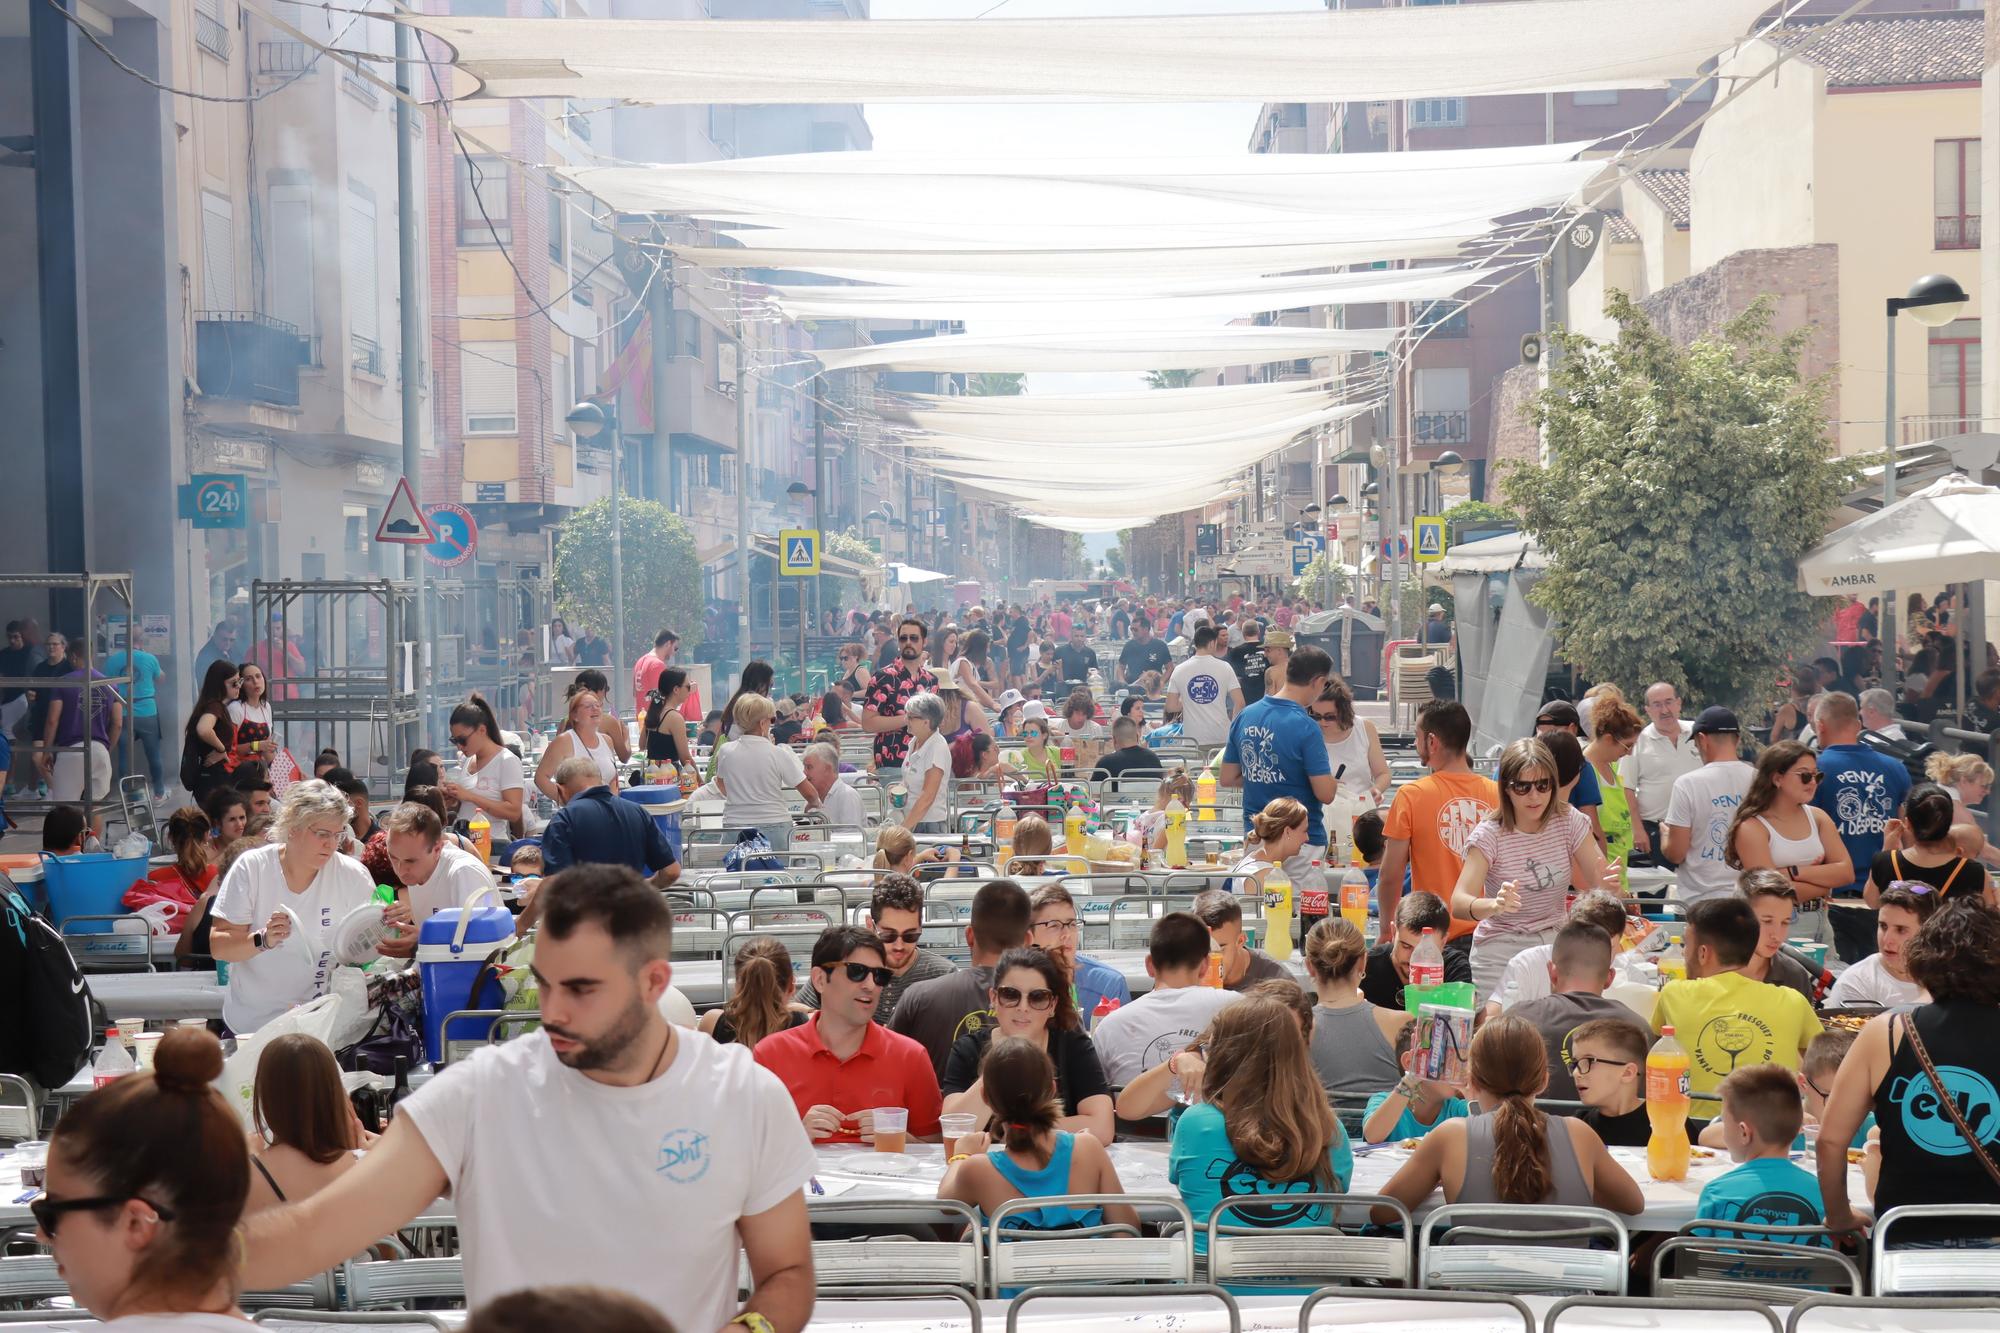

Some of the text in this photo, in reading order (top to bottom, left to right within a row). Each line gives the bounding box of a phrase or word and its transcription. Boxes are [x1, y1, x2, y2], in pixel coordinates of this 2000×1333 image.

[425, 504, 464, 517] EXCEPTO
[440, 525, 453, 543] P
[443, 542, 475, 567] DESCARGA
[1831, 573, 1876, 586] AMBAR
[1245, 725, 1275, 740] PENYA
[1837, 770, 1884, 784] PENYA
[1712, 793, 1742, 808] PEN
[1082, 901, 1128, 912] Levate
[1695, 1048, 1713, 1073] PENYA
[1753, 1207, 1787, 1219] penya
